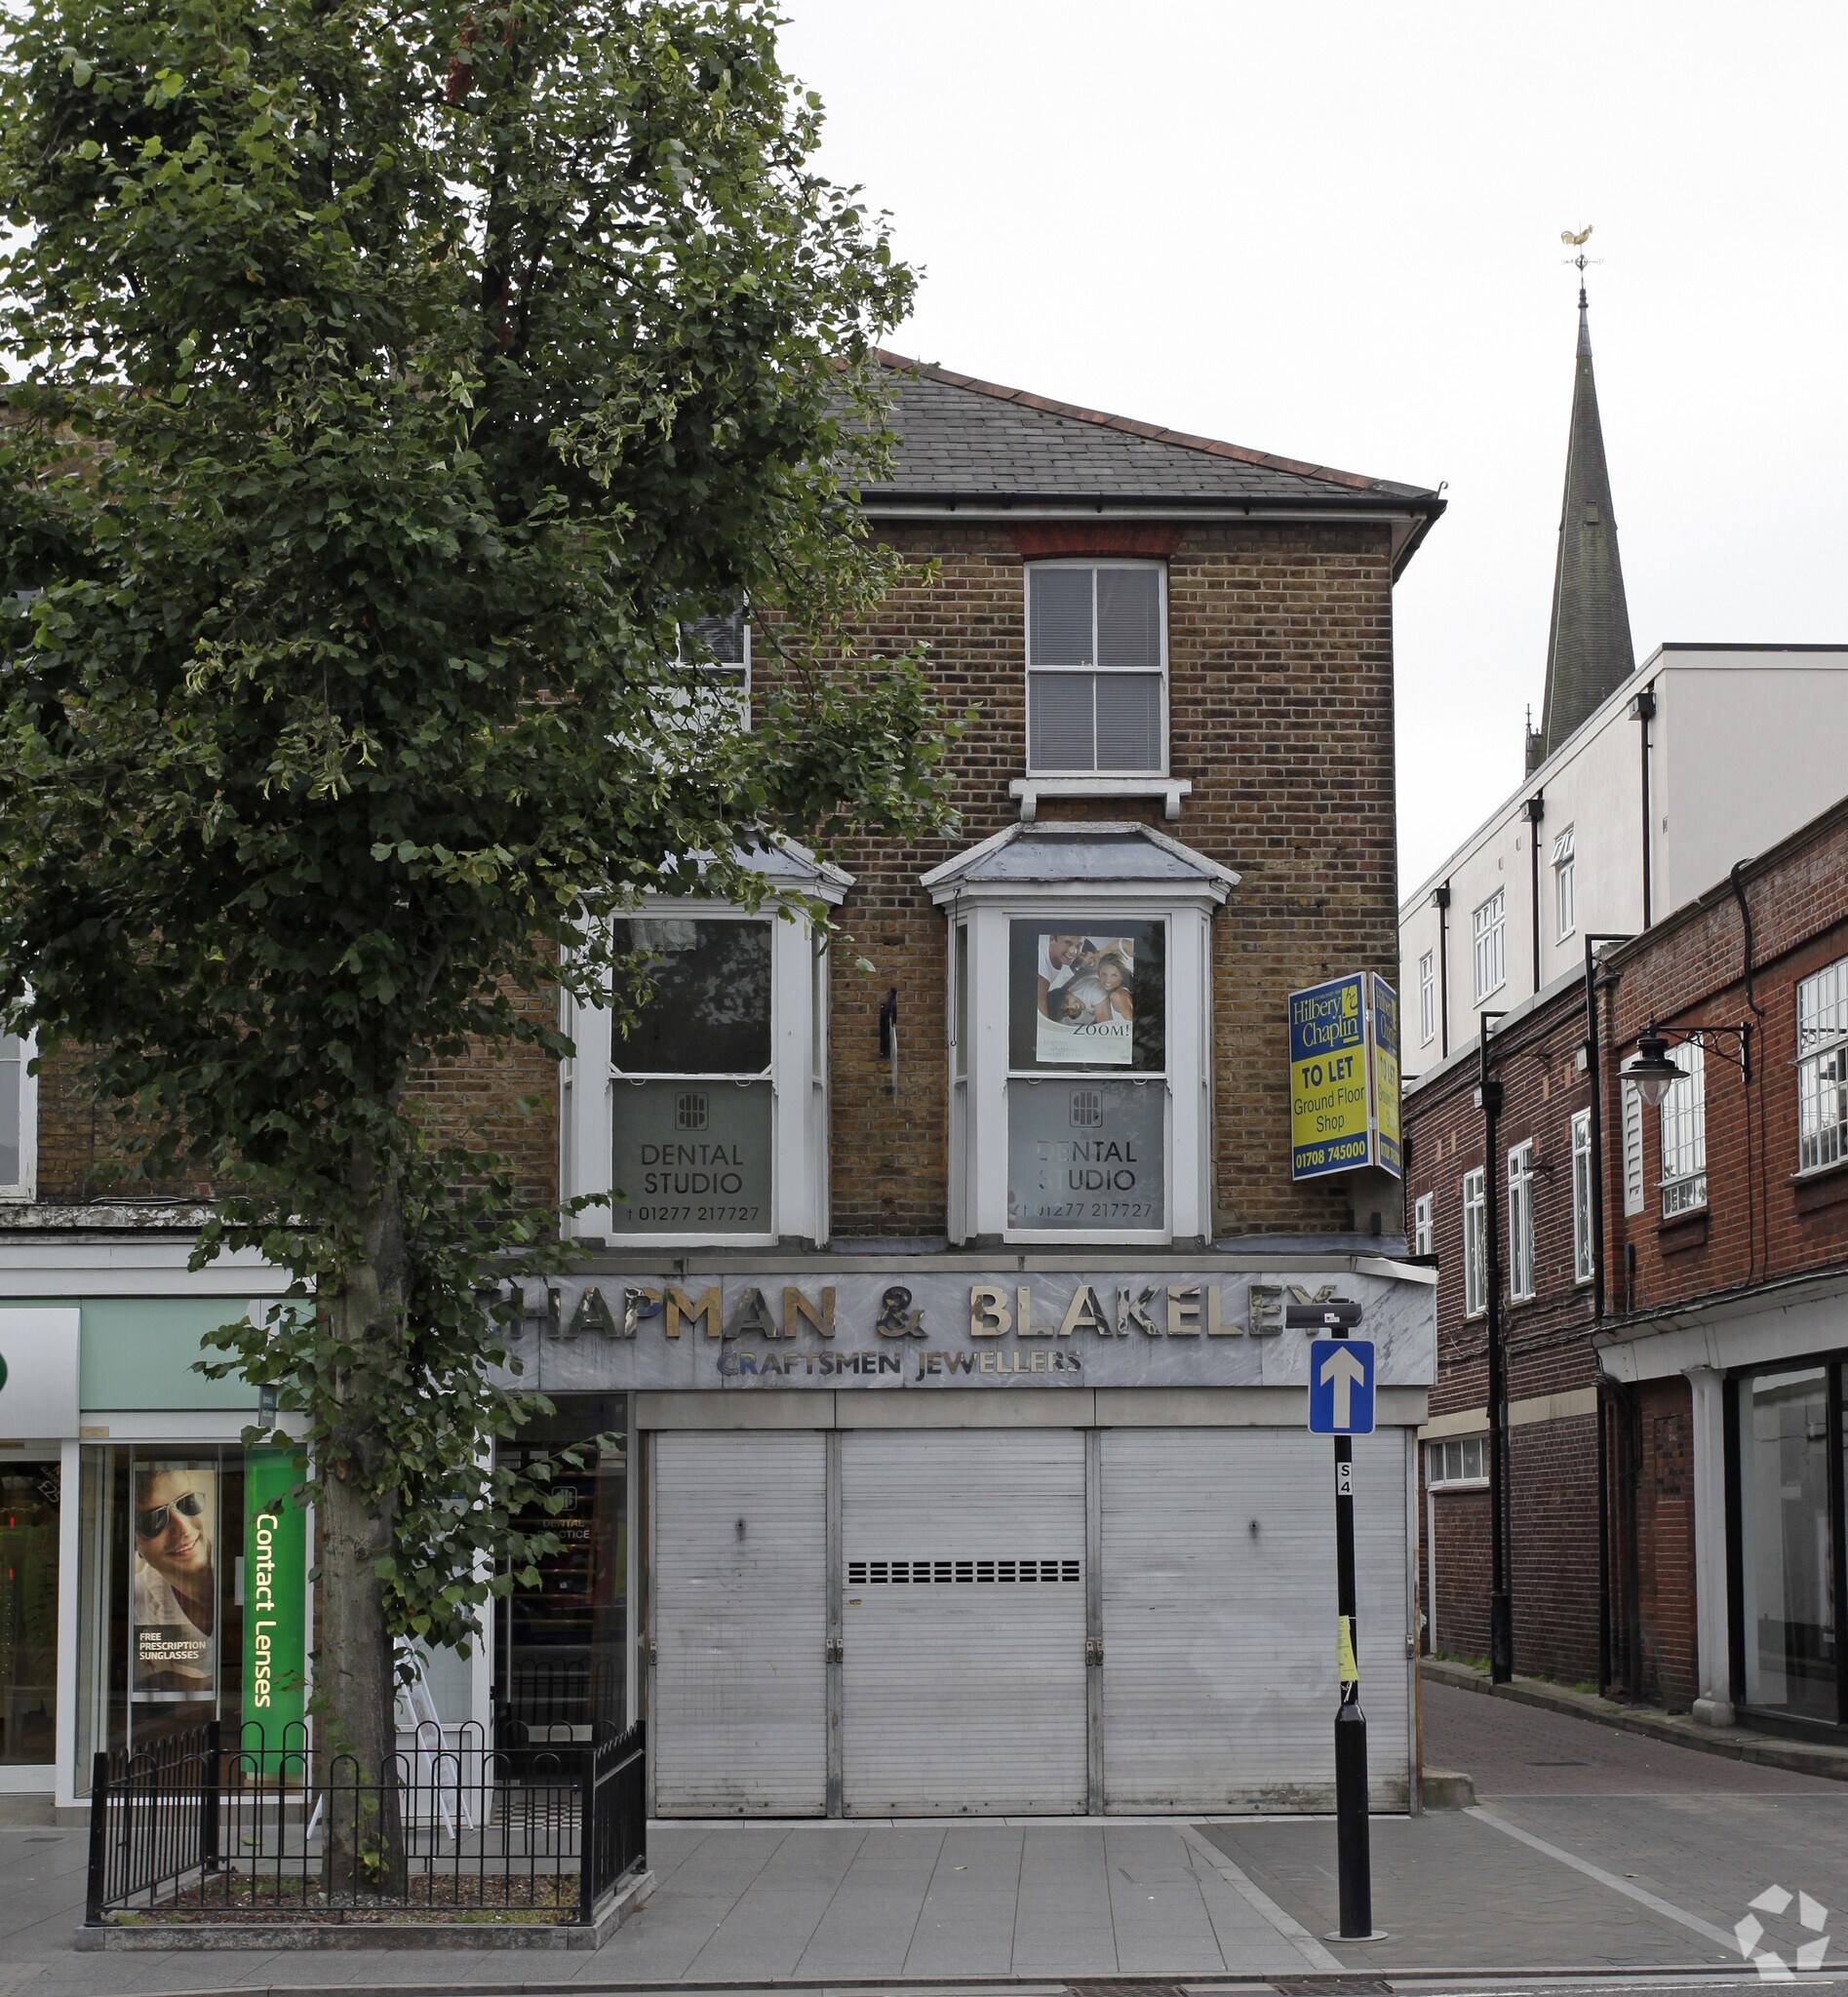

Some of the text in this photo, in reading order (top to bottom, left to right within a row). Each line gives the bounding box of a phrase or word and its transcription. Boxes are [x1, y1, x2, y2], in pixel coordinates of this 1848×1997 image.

[1294, 997, 1342, 1025] Hilbery
[1073, 1022, 1129, 1037] ZOOM!
[1303, 1014, 1358, 1047] Chaplin
[1302, 1056, 1353, 1088] TO LET
[1294, 1091, 1334, 1116] Ground
[1337, 1087, 1364, 1106] Floor
[1316, 1115, 1345, 1133] Shop
[642, 1144, 743, 1165] DENTAL
[1038, 1141, 1137, 1162] DENTAL
[1296, 1150, 1324, 1169] 01708
[1328, 1140, 1365, 1162] 745000
[645, 1173, 742, 1194] STUDIO
[639, 1207, 690, 1220] 01277
[697, 1207, 759, 1220] 217727
[1092, 1203, 1152, 1217] 217727
[877, 1285, 928, 1339] &
[717, 1351, 1081, 1382] CRAFTSMEN JEWELLERS
[1341, 1465, 1350, 1476] S
[1340, 1481, 1351, 1493] 4
[542, 1519, 585, 1528] DENTAL
[537, 1530, 591, 1539] PCTICE
[255, 1513, 278, 1708] Contact Lenses
[139, 1632, 162, 1641] FREE
[139, 1641, 207, 1650] PRESCRIPTION
[139, 1651, 200, 1660] SUNGLASSES
